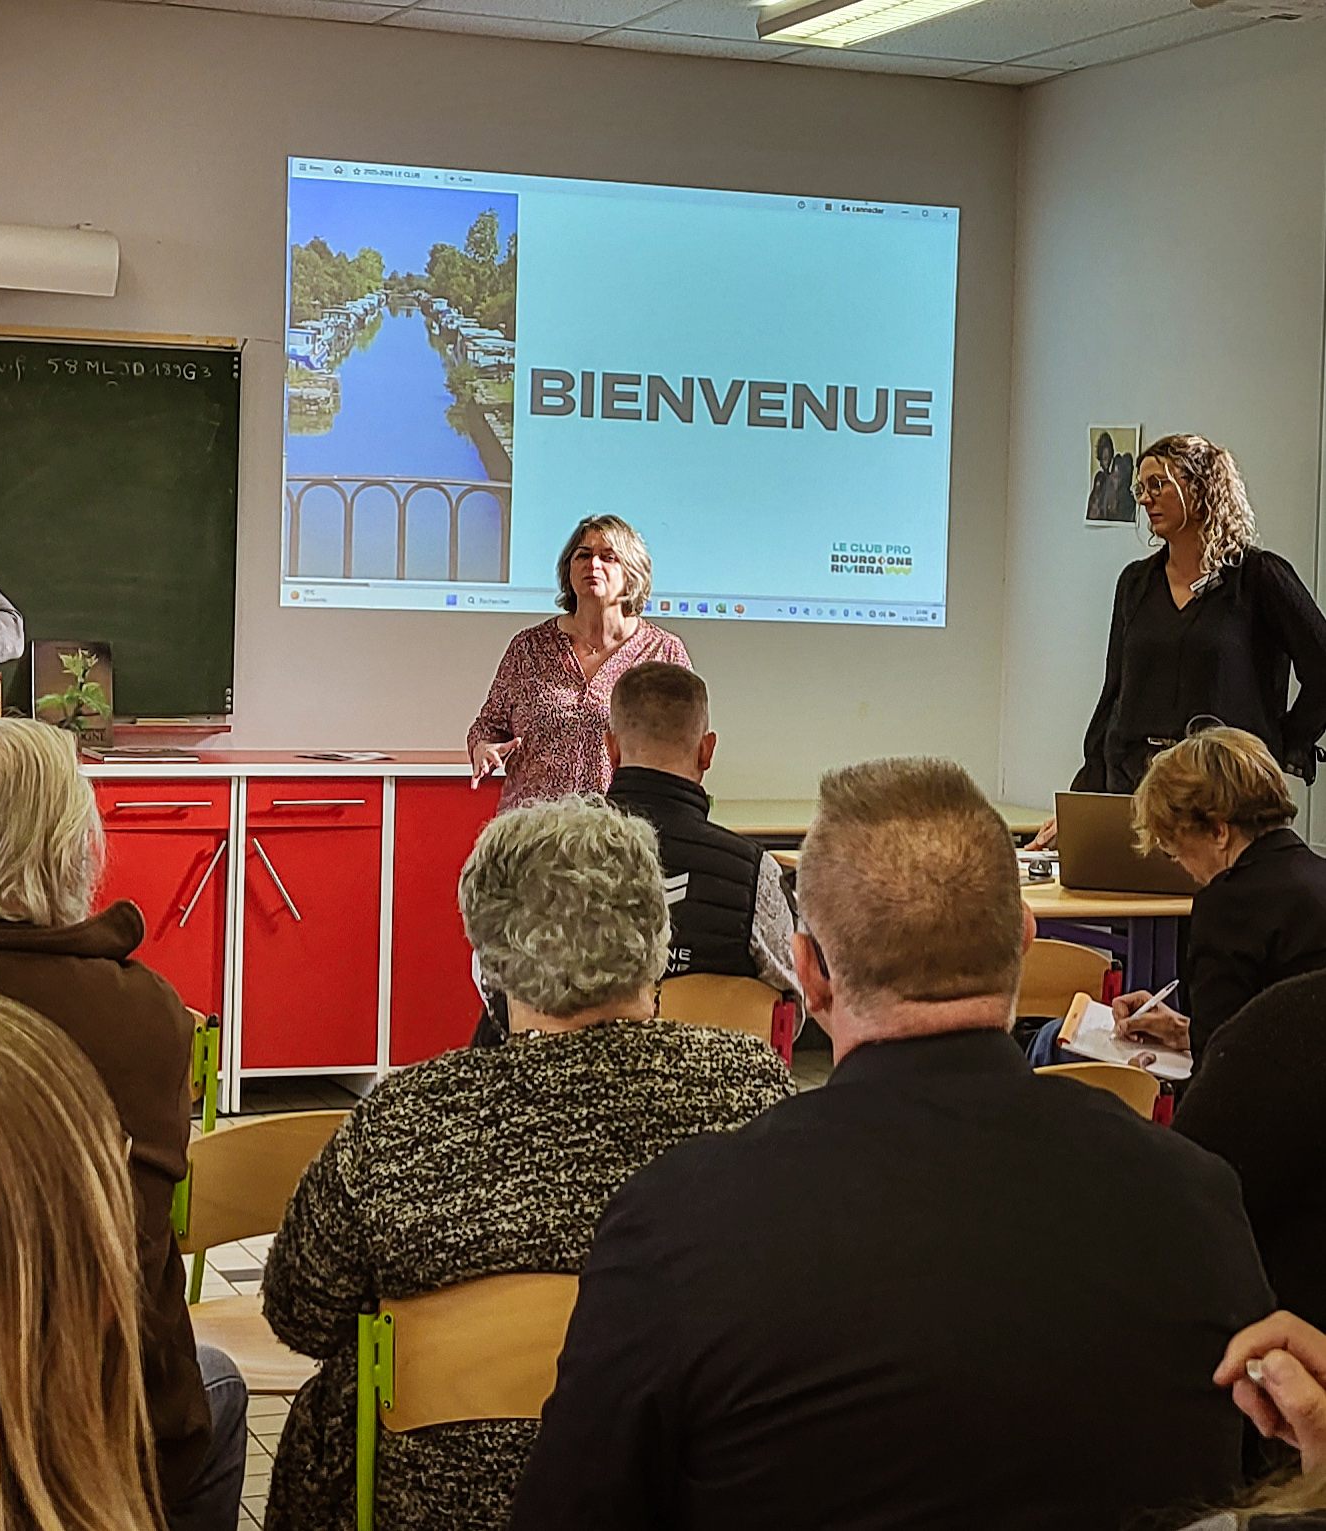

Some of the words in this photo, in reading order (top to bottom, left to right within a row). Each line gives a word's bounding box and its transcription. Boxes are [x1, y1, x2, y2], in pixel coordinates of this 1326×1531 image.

[530, 367, 934, 437] BIENVENUE
[832, 542, 846, 551] LE
[850, 543, 882, 553] CLUB
[885, 544, 911, 554] PRO
[831, 565, 884, 574] RIVIERA
[667, 946, 691, 960] NE
